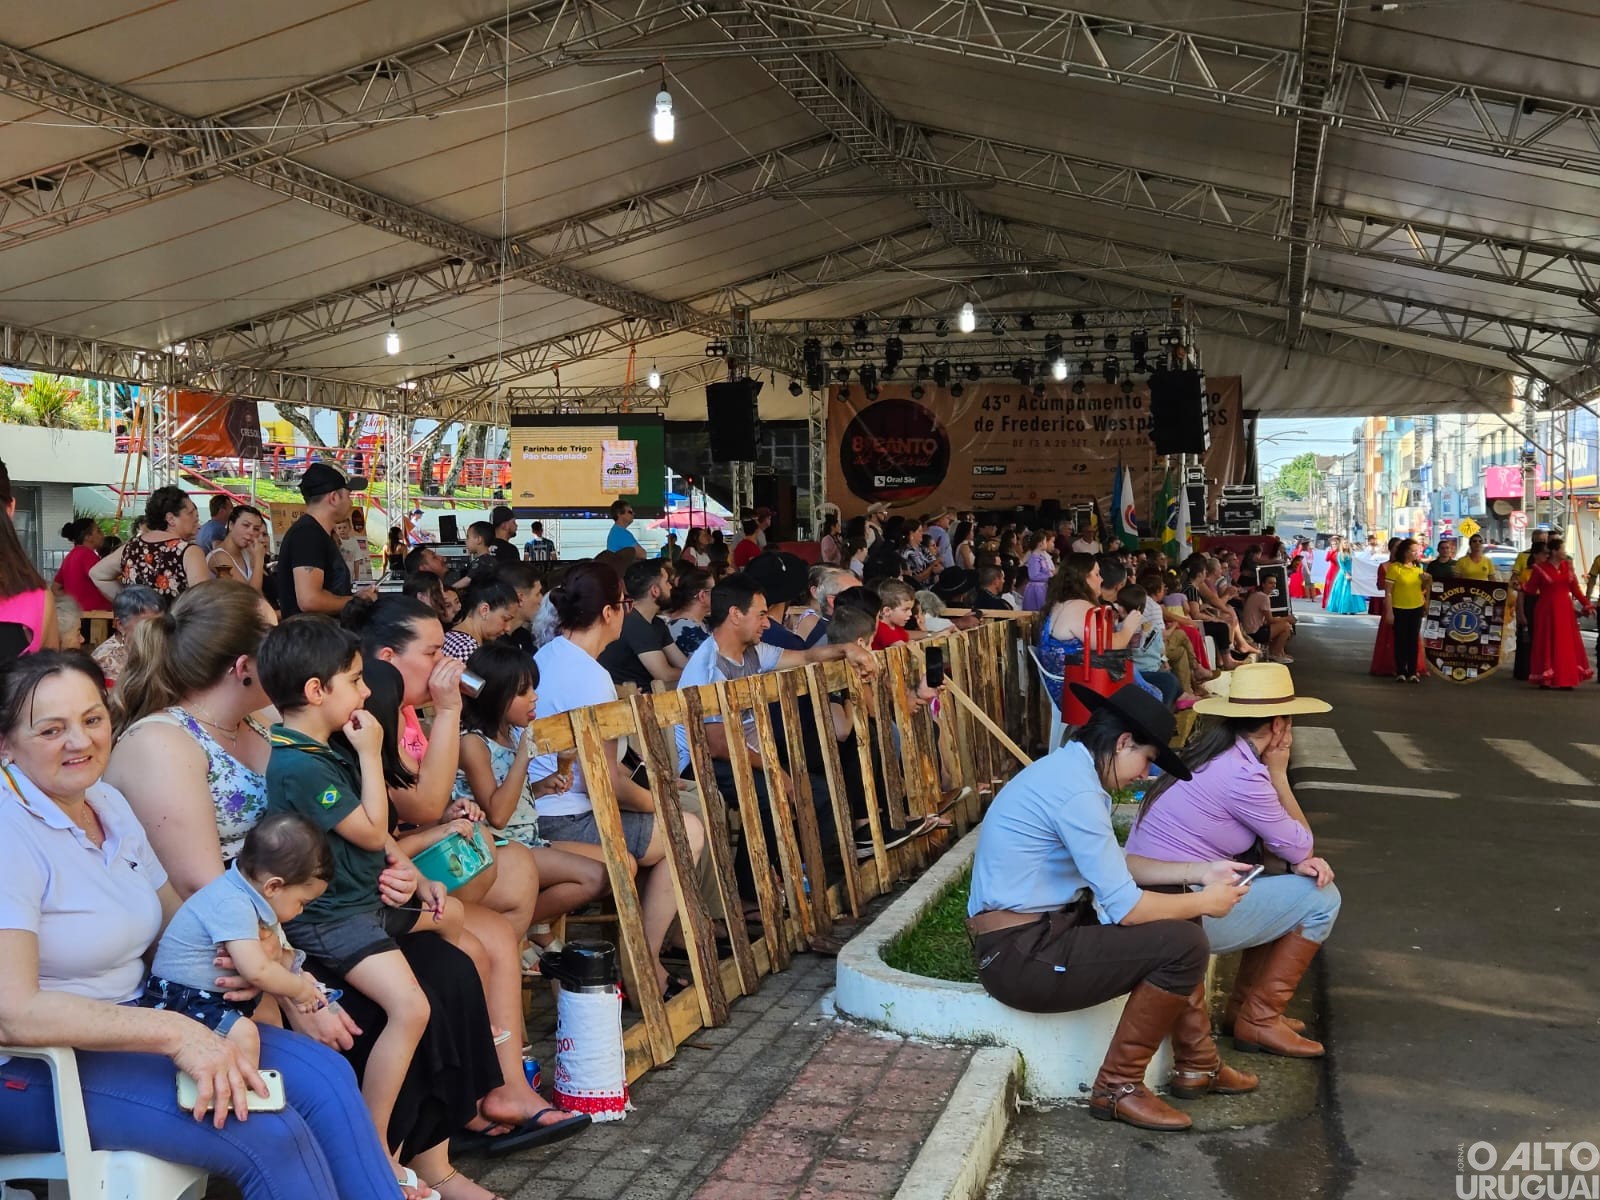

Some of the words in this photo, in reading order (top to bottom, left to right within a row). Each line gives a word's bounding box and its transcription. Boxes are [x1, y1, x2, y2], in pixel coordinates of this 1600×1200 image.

[982, 394, 1010, 411] 43º
[1018, 393, 1143, 415] Acampamento
[974, 416, 994, 432] de
[1001, 414, 1086, 432] Frederico
[1093, 413, 1153, 434] Westp
[523, 445, 555, 453] Farinha
[556, 445, 568, 453] de
[570, 445, 593, 454] Trigo
[1012, 439, 1024, 448] DE
[1044, 439, 1050, 448] A
[1099, 437, 1132, 449] PRAÇA
[541, 453, 588, 461] Congelado
[886, 475, 903, 484] Oral
[904, 475, 916, 485] Sin
[1440, 587, 1465, 600] LIONS
[1470, 588, 1495, 605] CLUBE
[1460, 614, 1471, 629] L
